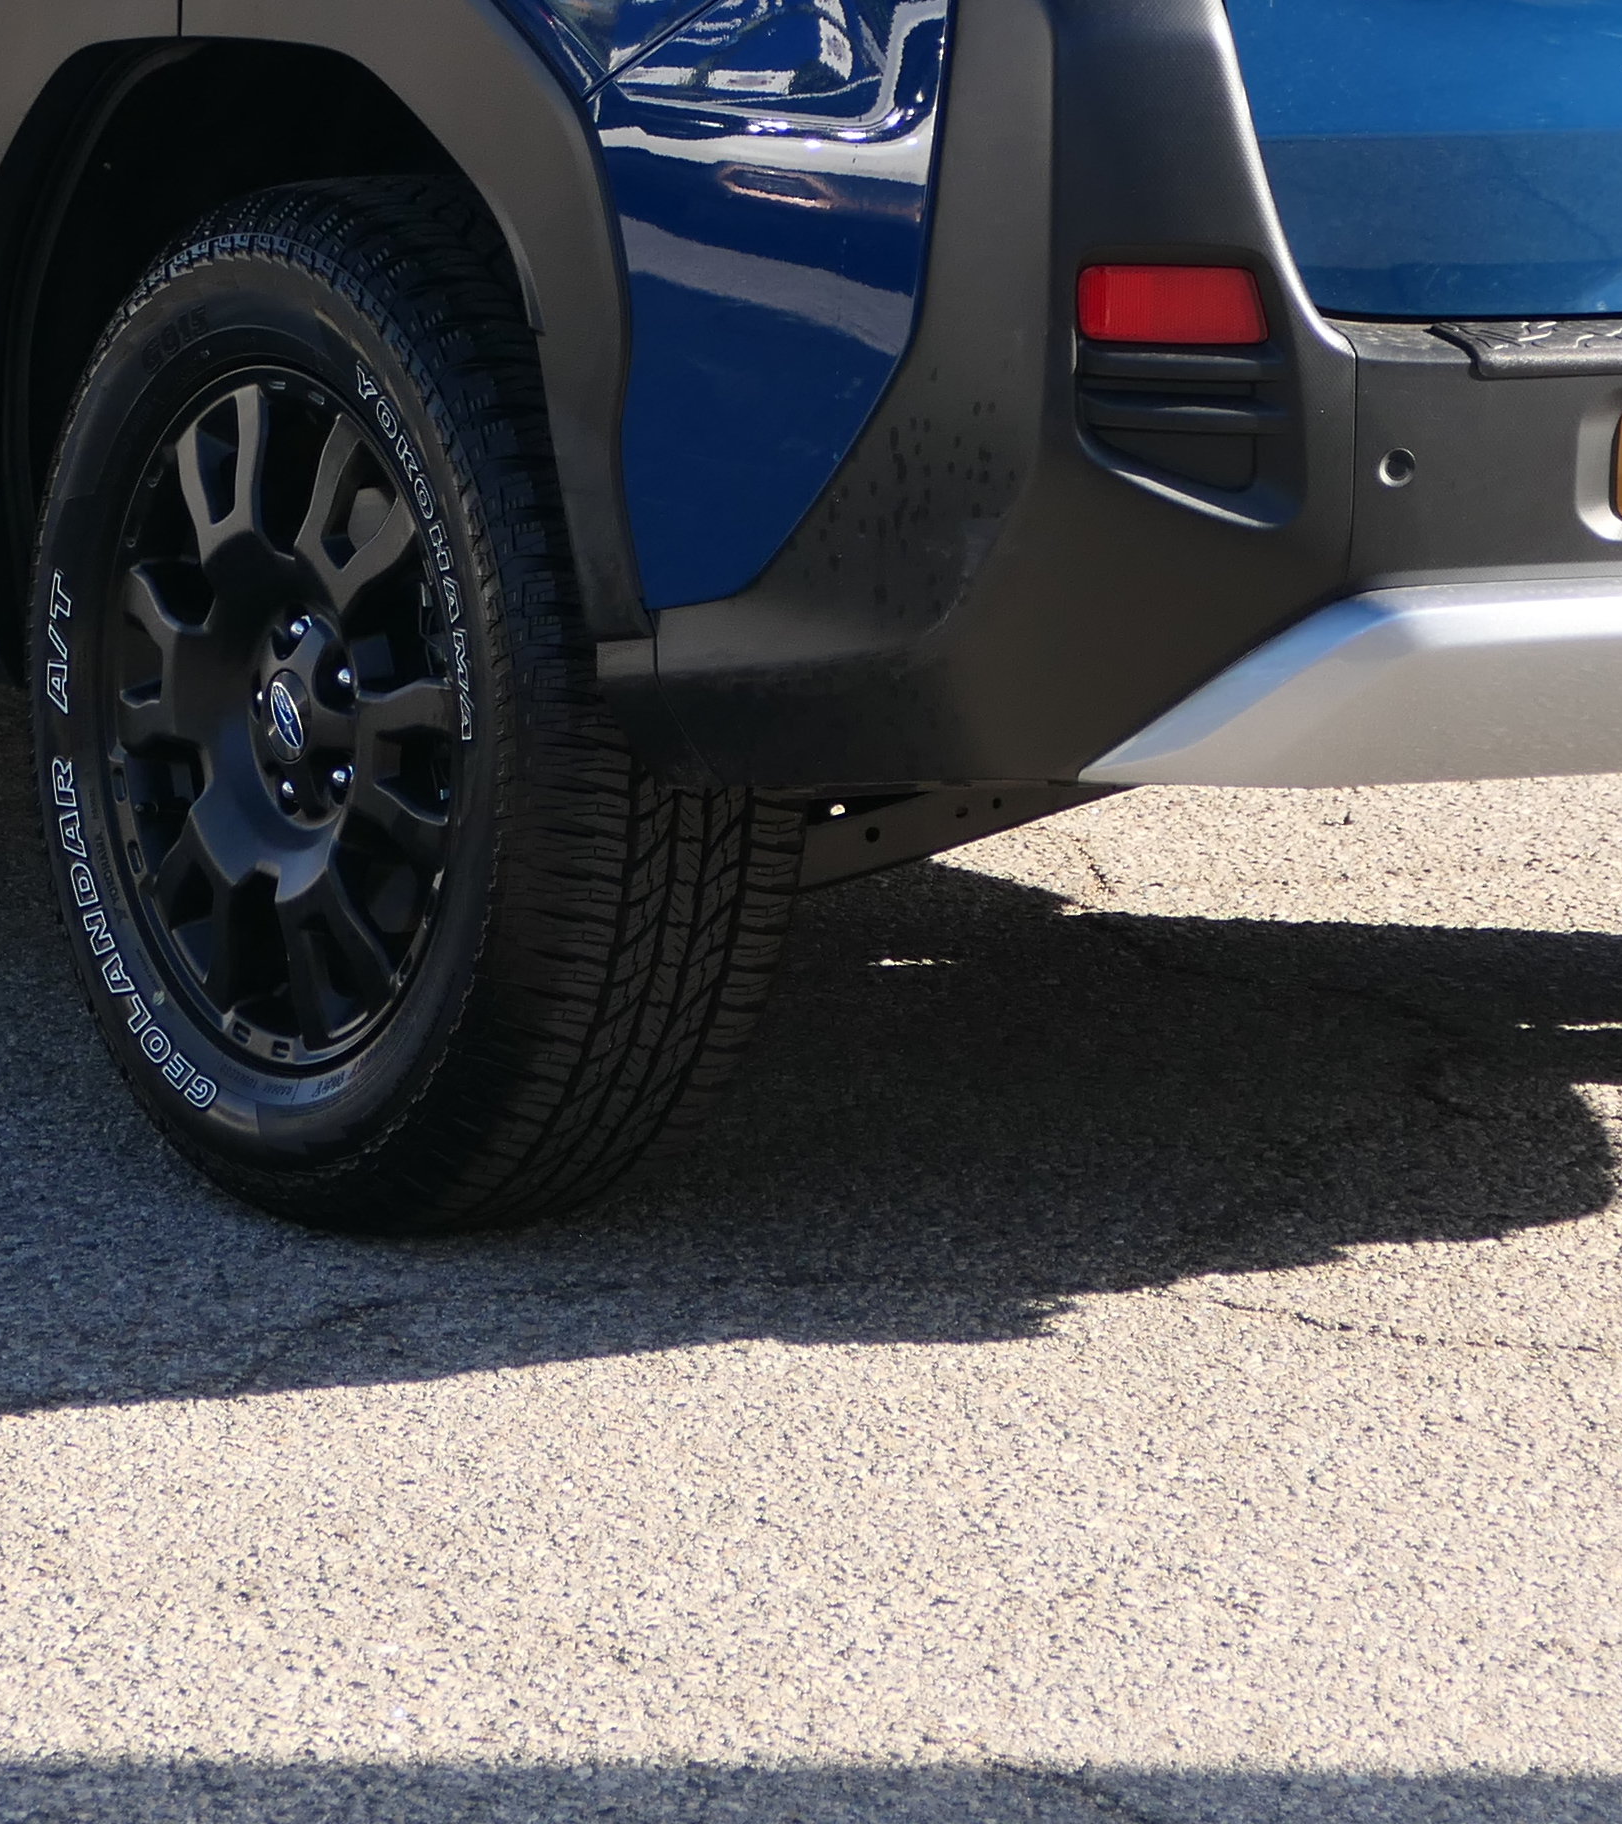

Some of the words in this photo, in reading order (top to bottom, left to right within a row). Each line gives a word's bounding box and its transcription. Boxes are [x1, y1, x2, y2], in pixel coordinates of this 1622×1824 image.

[47, 567, 75, 715] A/T
[355, 359, 475, 742] YOKOHAMA
[50, 755, 217, 1112] GEOLANDAR
